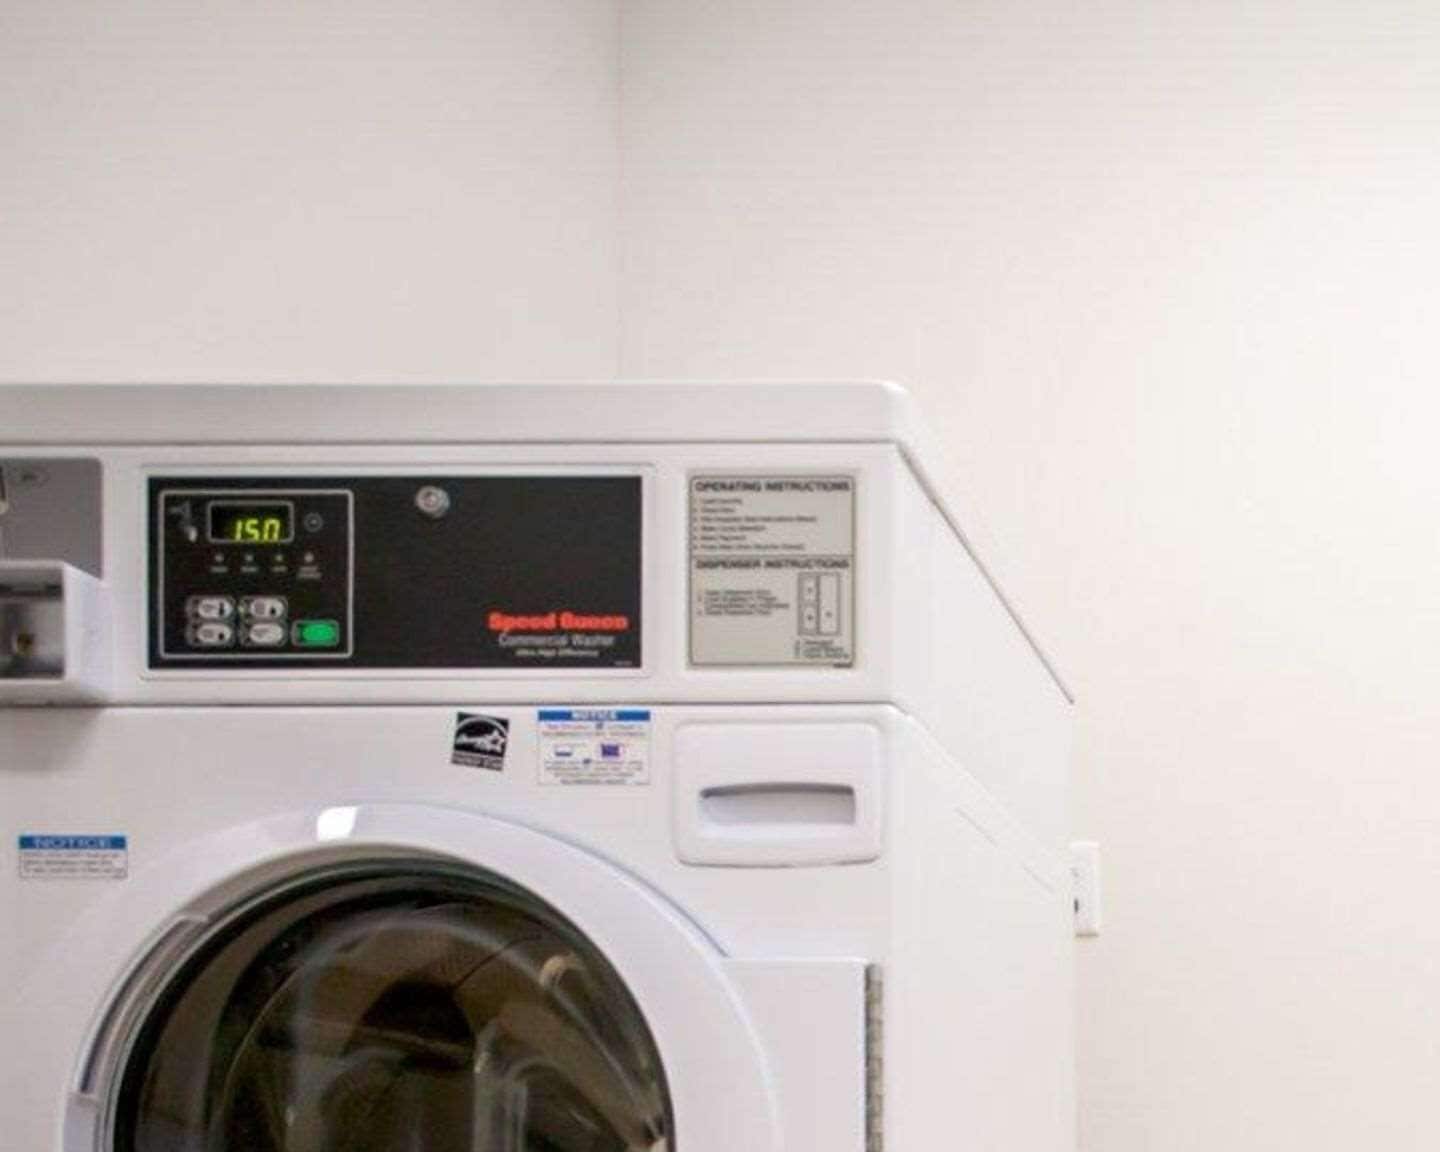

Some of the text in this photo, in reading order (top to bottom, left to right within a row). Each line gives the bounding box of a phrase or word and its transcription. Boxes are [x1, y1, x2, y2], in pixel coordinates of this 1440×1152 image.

[695, 480, 850, 492] OPERATING INSTRUCTIONS
[763, 559, 850, 569] INSTRUCTIONS
[488, 611, 628, 632] Speed Queen
[499, 633, 569, 648] Commercial
